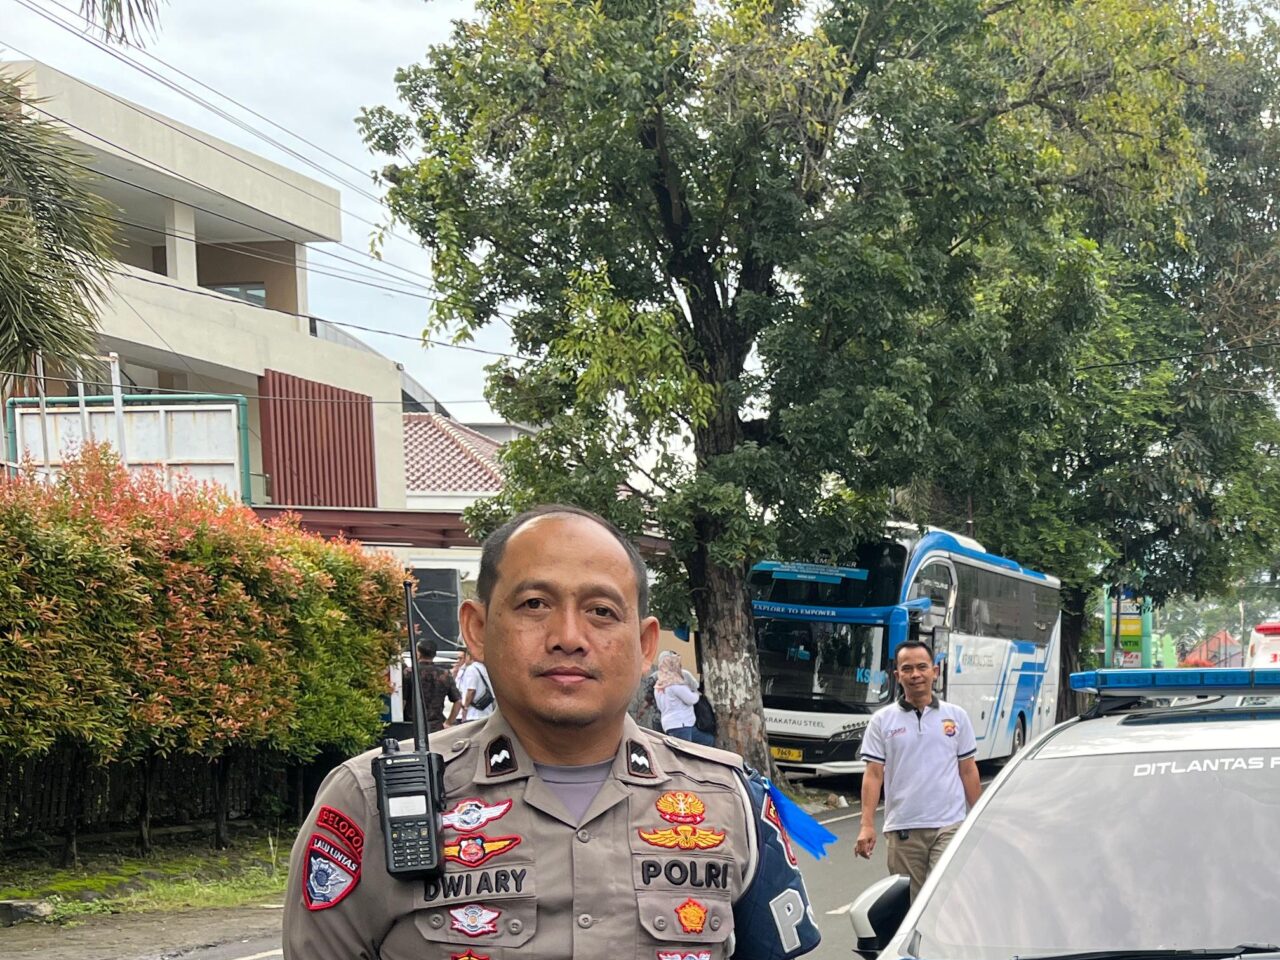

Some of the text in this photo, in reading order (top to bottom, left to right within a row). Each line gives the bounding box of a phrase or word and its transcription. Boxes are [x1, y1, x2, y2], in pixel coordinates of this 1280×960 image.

[787, 607, 799, 615] TO
[800, 608, 837, 617] EMPOWER
[803, 720, 826, 729] STEEL
[1133, 756, 1265, 777] DITLANTAS
[475, 868, 527, 895] ARY
[642, 859, 729, 889] POLRI
